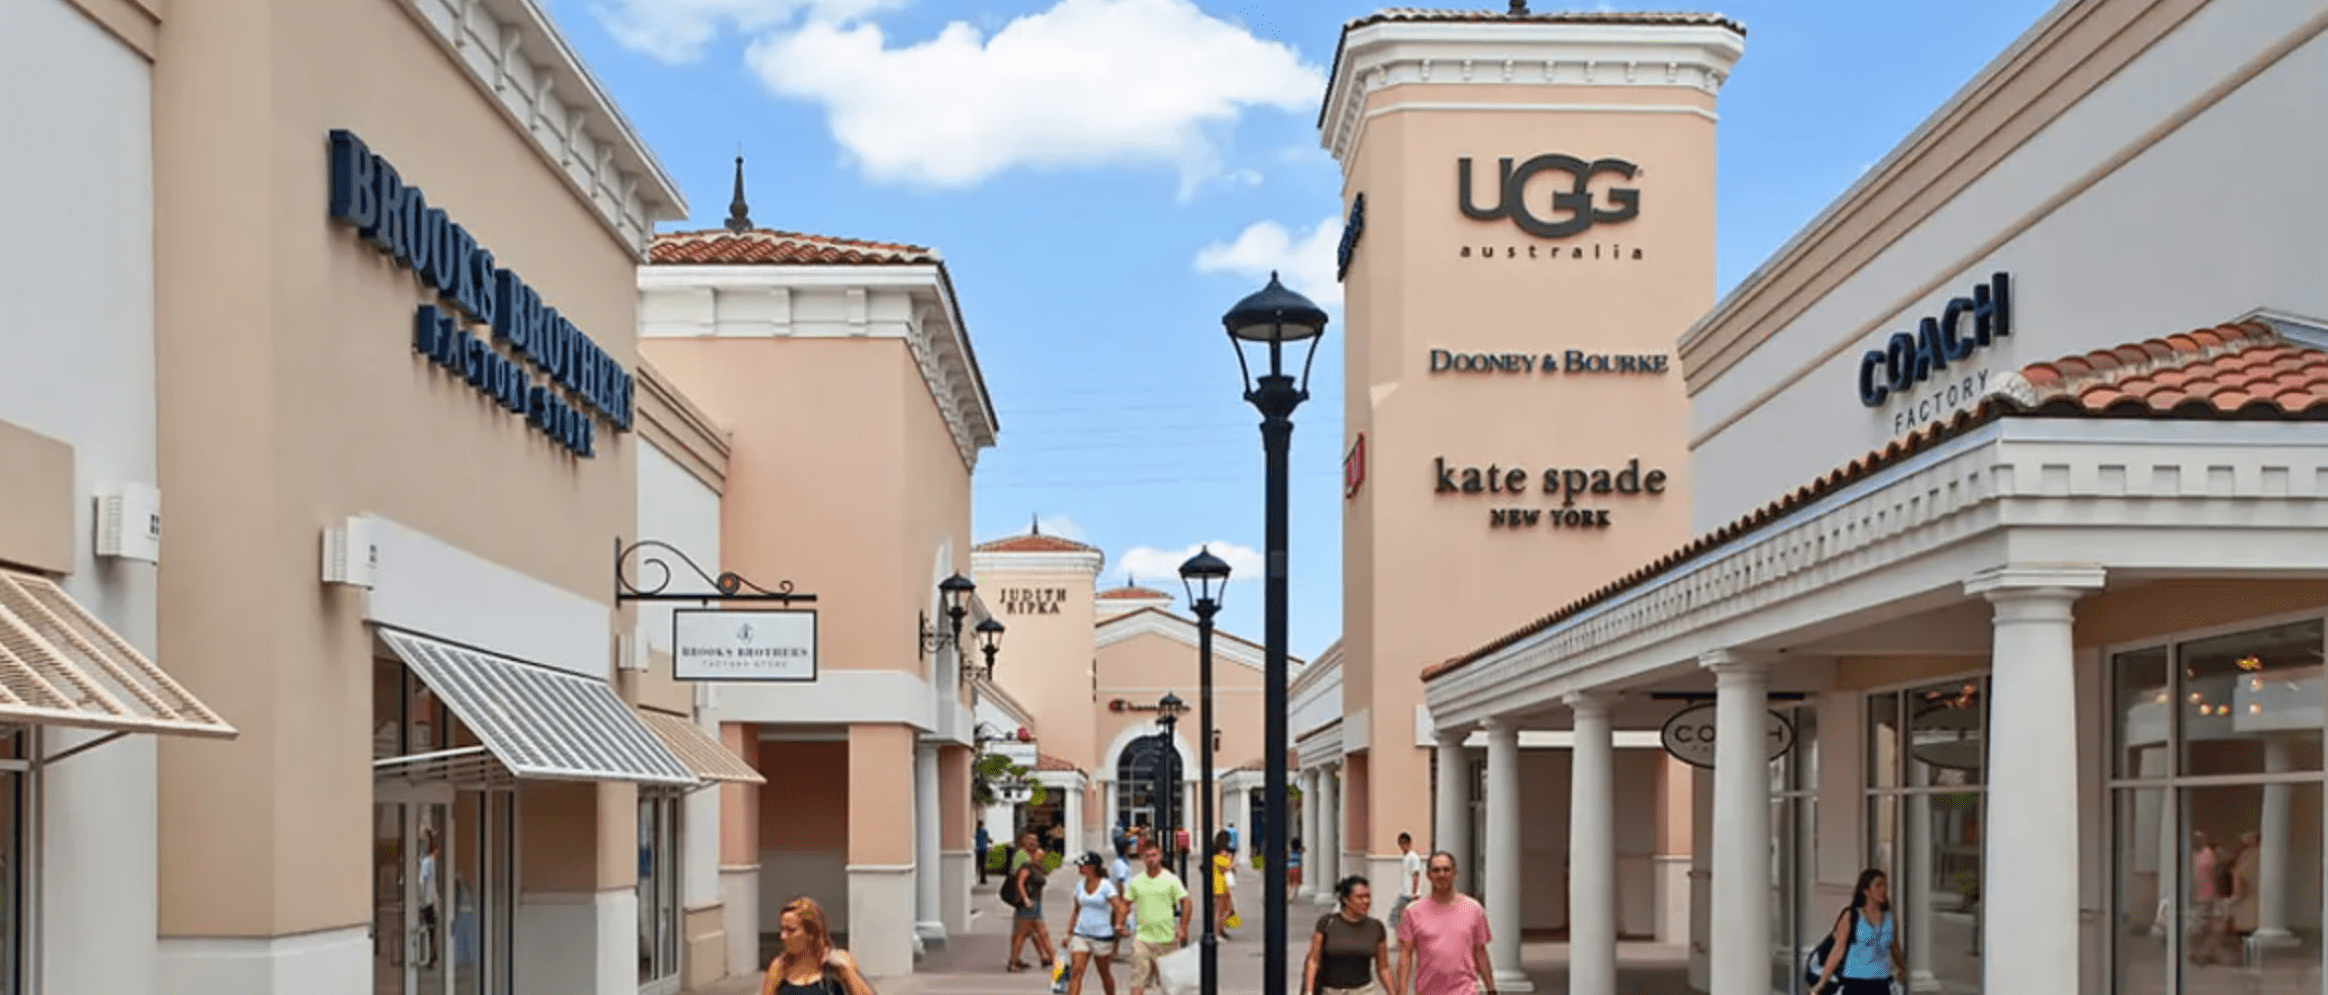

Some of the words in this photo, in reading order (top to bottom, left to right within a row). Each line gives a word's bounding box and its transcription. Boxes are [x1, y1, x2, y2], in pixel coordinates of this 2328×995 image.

[1457, 153, 1640, 239] UGG
[1460, 243, 1644, 261] australia
[329, 129, 496, 325] BROOKS
[492, 268, 634, 432] BROTHERS
[1859, 271, 2011, 408] COACH
[1430, 348, 1538, 374] DOONEY
[1541, 351, 1558, 374] &
[1564, 348, 1669, 374] BOURKE
[412, 303, 531, 414] FACTORY
[525, 386, 597, 459] STORE
[1895, 368, 1989, 436] FACTORY
[1433, 456, 1528, 496] kate
[1543, 457, 1667, 506] spade
[1490, 508, 1540, 529] NEW
[1551, 508, 1612, 529] YORK
[1000, 588, 1066, 604] JUDITH
[1007, 602, 1060, 614] RIPKA
[682, 646, 733, 658] BROOKS
[738, 646, 808, 658] BROTHERS
[1108, 699, 1191, 715] Champn
[1675, 724, 1783, 743] COH
